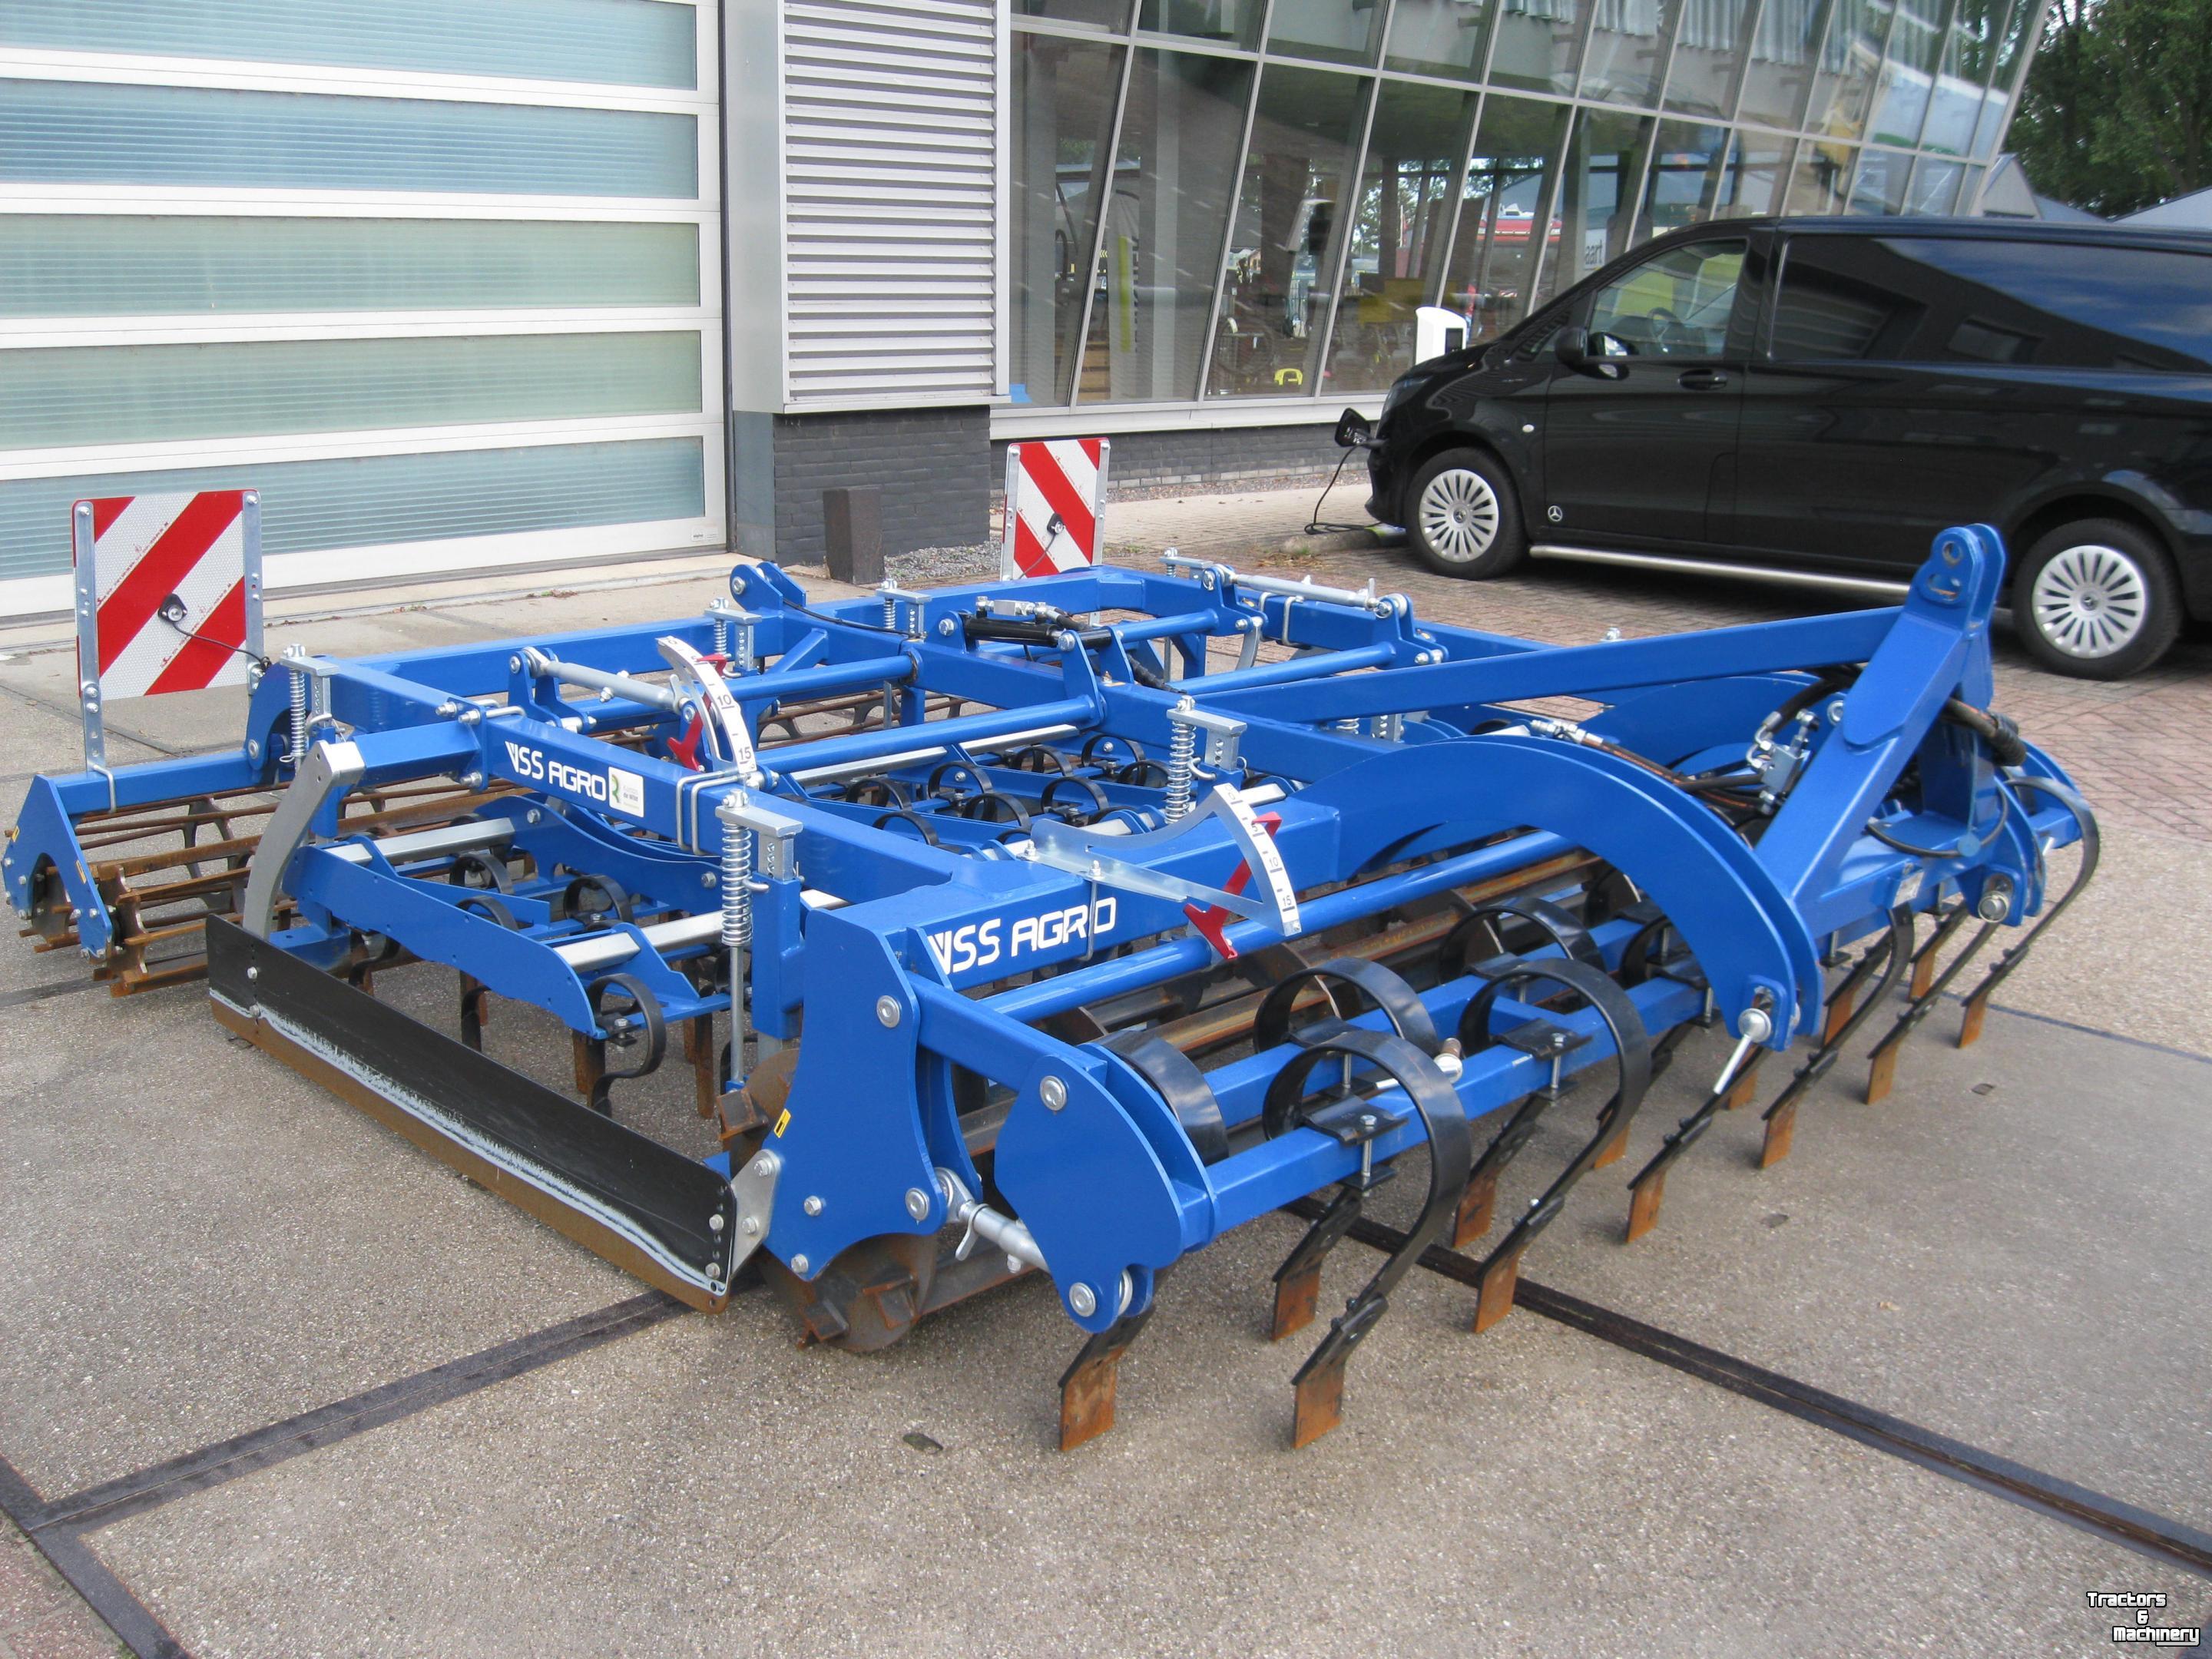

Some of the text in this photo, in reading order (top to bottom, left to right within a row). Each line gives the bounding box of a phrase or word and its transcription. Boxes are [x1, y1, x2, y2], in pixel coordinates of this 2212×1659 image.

[717, 694, 732, 706] 10
[739, 747, 752, 760] 15
[505, 741, 607, 801] VSS AGRO
[1269, 856, 1279, 868] 10
[1282, 895, 1292, 906] 15
[1011, 896, 1117, 957] AGRO
